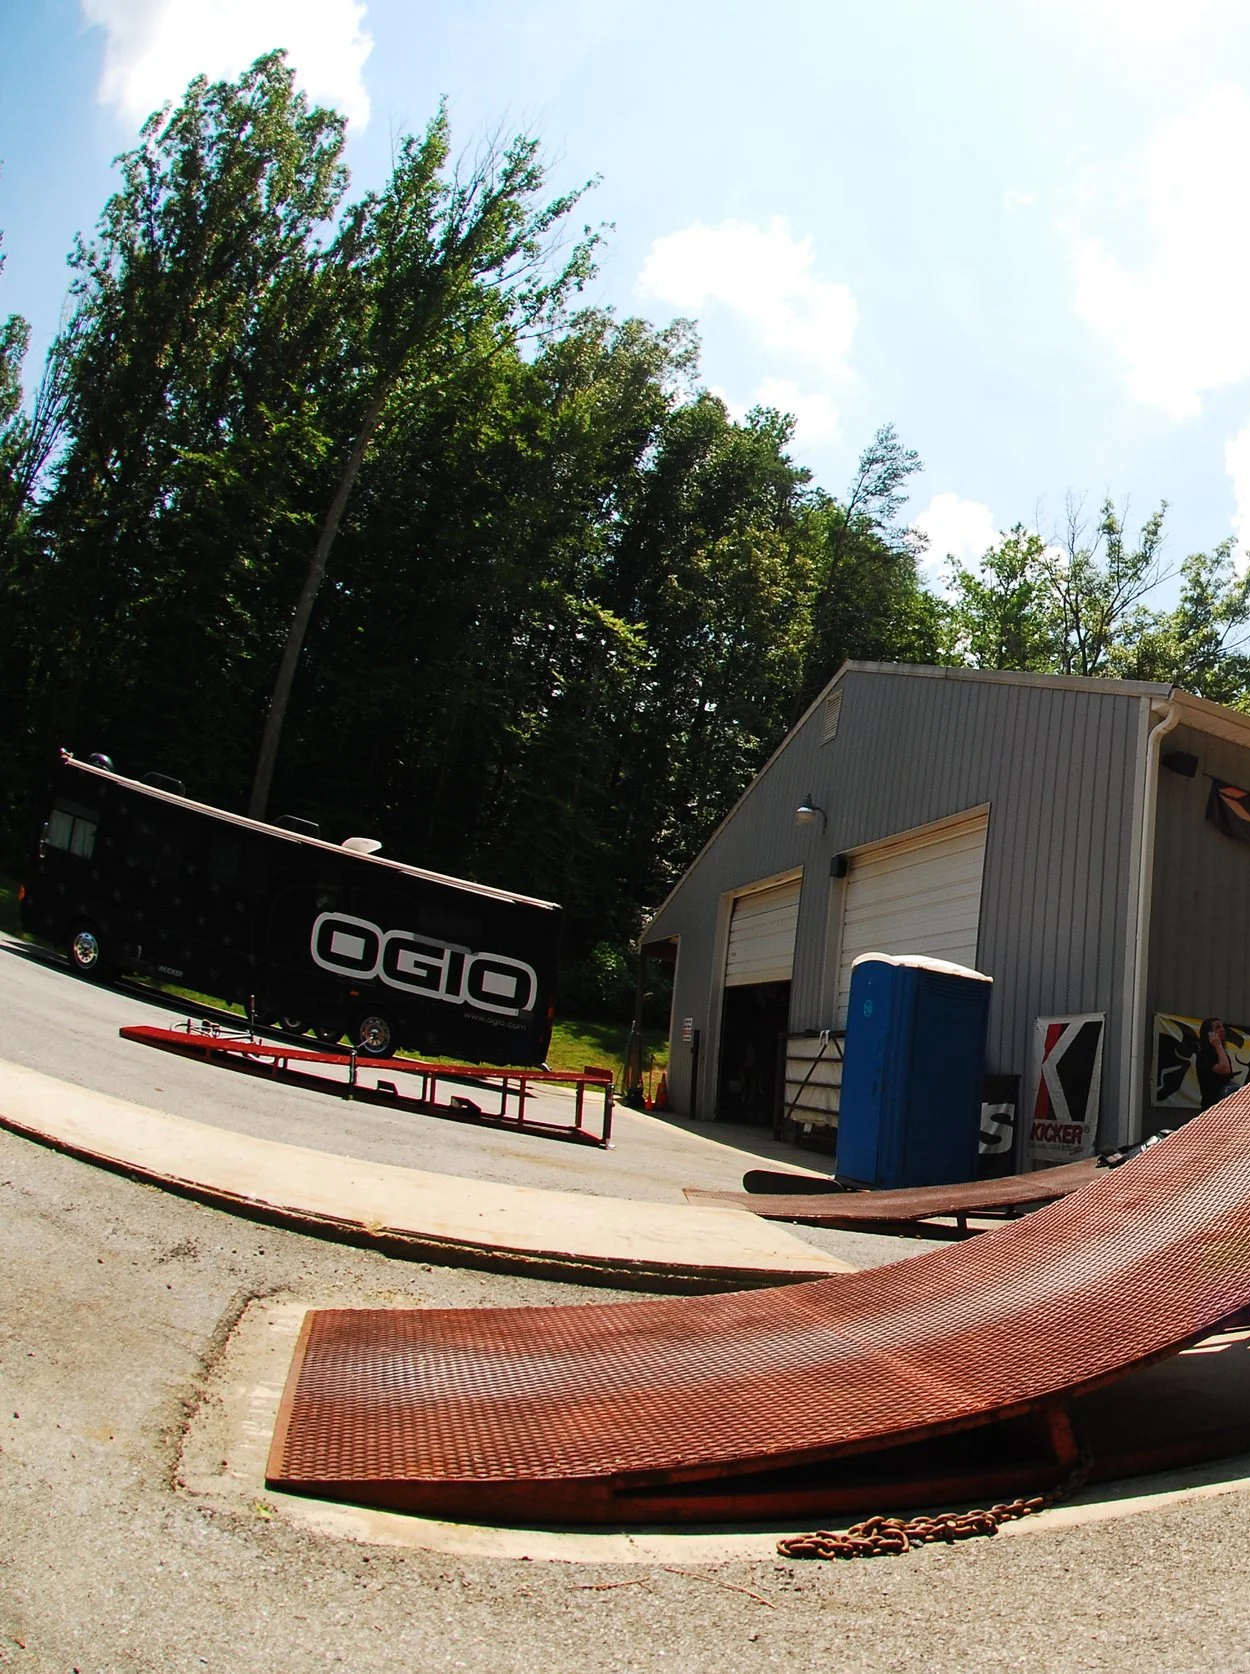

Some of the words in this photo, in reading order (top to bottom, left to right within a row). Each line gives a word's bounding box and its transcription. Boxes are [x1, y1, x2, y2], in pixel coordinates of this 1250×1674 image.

[311, 911, 538, 1017] OGIO
[463, 1012, 527, 1031] www.ogio.com
[1030, 1122, 1083, 1145] KICKER
